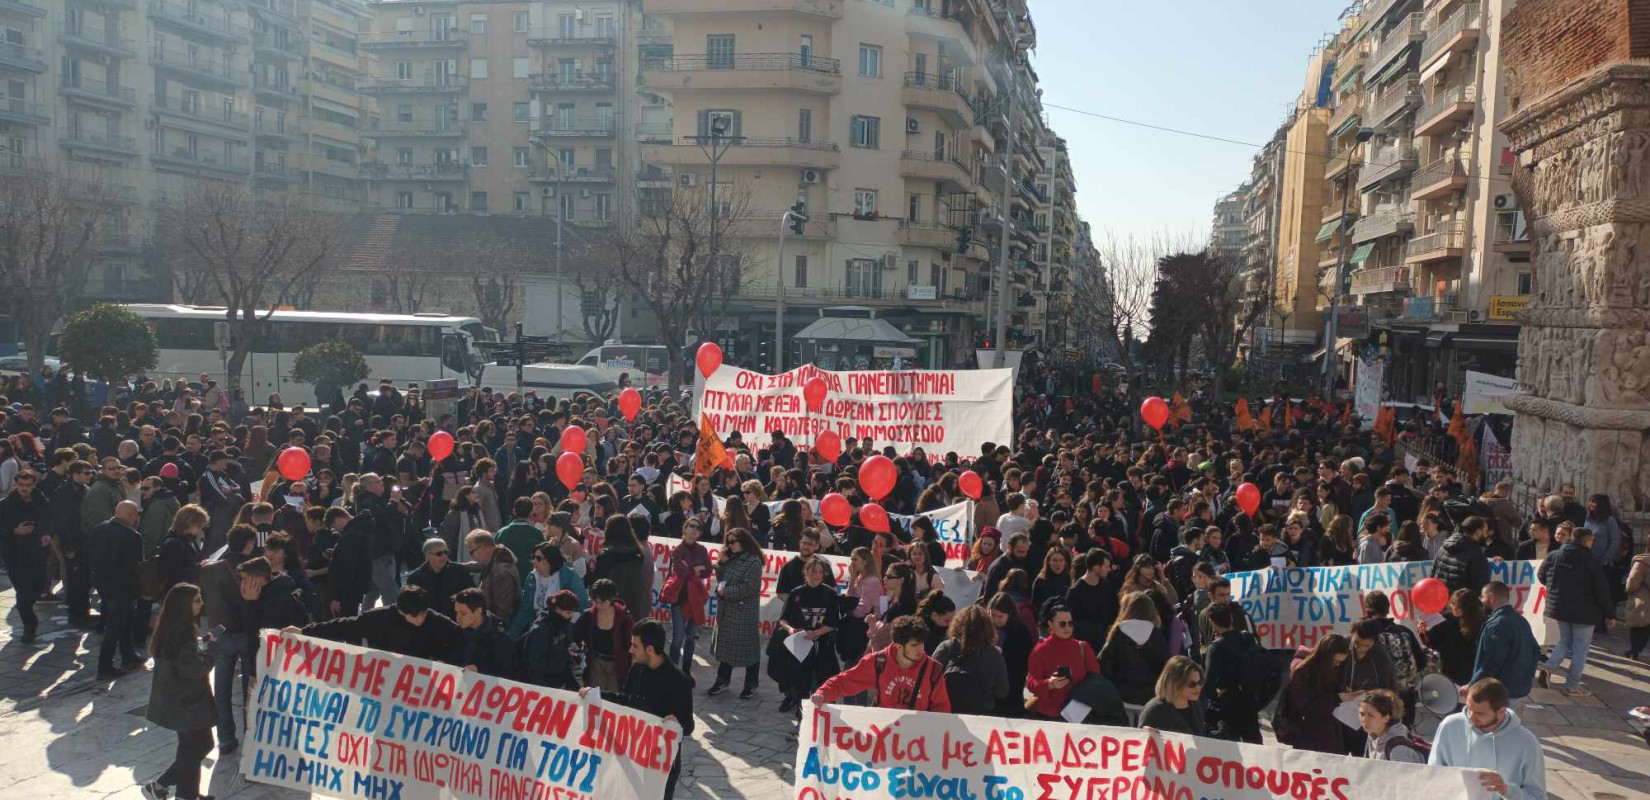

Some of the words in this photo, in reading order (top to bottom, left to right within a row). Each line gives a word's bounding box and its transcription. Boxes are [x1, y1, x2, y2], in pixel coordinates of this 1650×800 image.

[736, 371, 763, 390] ΟΧΙ
[767, 372, 793, 388] ΣΤΑ
[848, 371, 955, 395] ΠΑΝΕΠΙΣΤΗΜΙΑ!
[704, 390, 752, 412] ΠΤΥΧΙΑ
[755, 395, 774, 413] ΜΕ
[775, 395, 801, 413] ΑΞΙΑ
[826, 398, 874, 422] ΔΩΡΕΑΝ
[878, 401, 943, 421] ΣΠΟΥΔΕΣ
[723, 414, 757, 433] ΜΗΝ
[764, 416, 831, 437] ΚΑΤΑΤΕΘΕΙ
[837, 421, 851, 440] ΤΟ
[855, 423, 945, 444] ΝΟΜΟΣΧΕΔΙΟ
[1265, 567, 1360, 595] ΙΔΙΩΤΙΚΑ
[1293, 593, 1352, 624] ΤΟΥΣ
[349, 653, 391, 697] ΜΕ
[460, 679, 579, 740] ΔΩΡΕΑΝ
[579, 703, 678, 774] ΣΠΟΥΔΕΣ
[292, 682, 350, 724] ΕΙΝΑΙ
[355, 697, 382, 733] ΤΟ
[384, 704, 491, 780] ΣΥΓΧΡΟΝΟ
[495, 732, 530, 771] ΓΙΑ
[536, 740, 602, 793] ΤΟΥΣ
[812, 707, 931, 764] Πτυχία
[942, 731, 978, 770] με
[1061, 731, 1187, 775] ΔΩΡΕΑΝ
[337, 731, 369, 767] ΟΧΙ
[373, 739, 408, 776] ΣΤΑ
[413, 749, 483, 798] ΙΔΙΩΤΙΚΑ
[353, 770, 405, 800] ΜΗΧ
[983, 775, 1025, 800] το
